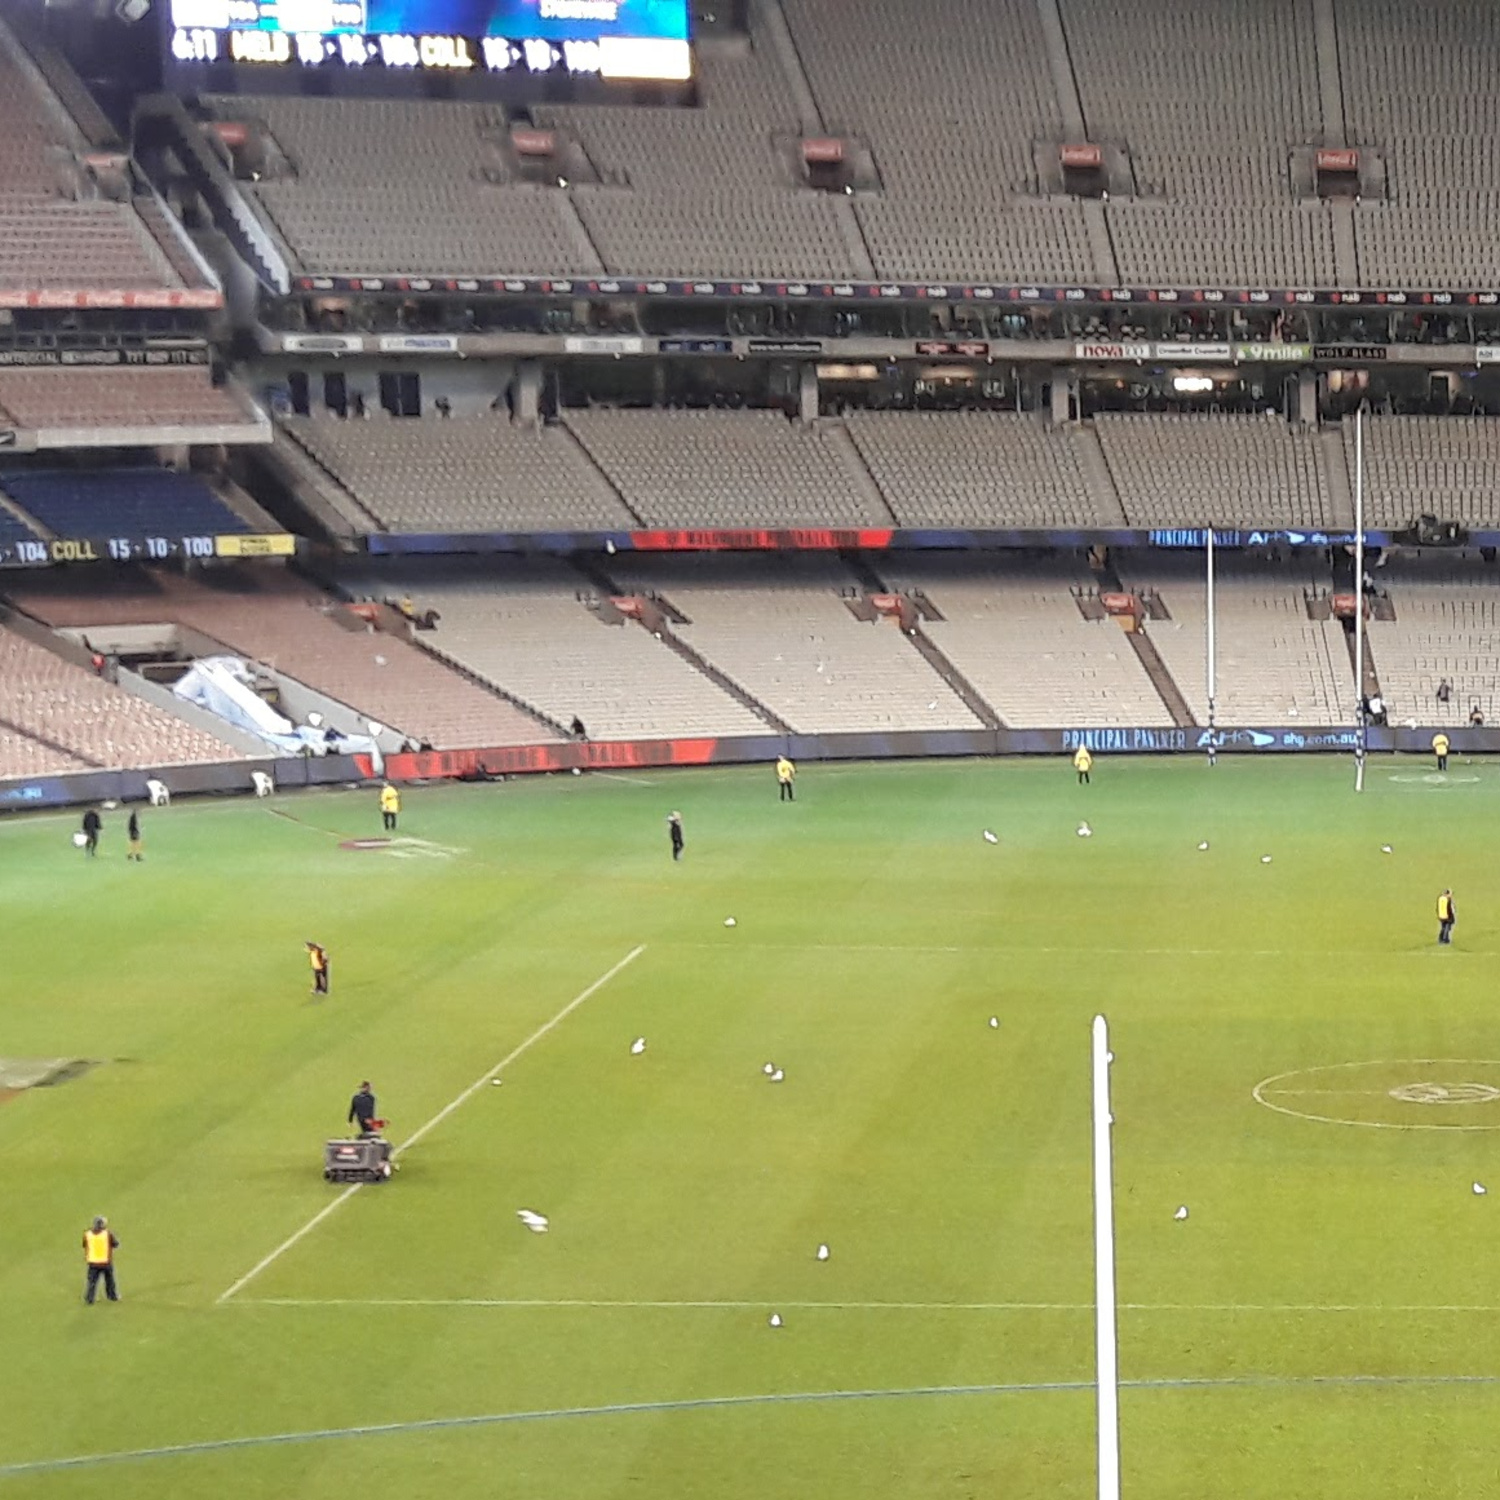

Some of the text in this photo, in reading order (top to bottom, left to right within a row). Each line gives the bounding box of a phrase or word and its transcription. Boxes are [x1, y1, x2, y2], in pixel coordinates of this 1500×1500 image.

[1083, 345, 1124, 356] nova
[17, 537, 213, 562] 104 COLL 15 10 100
